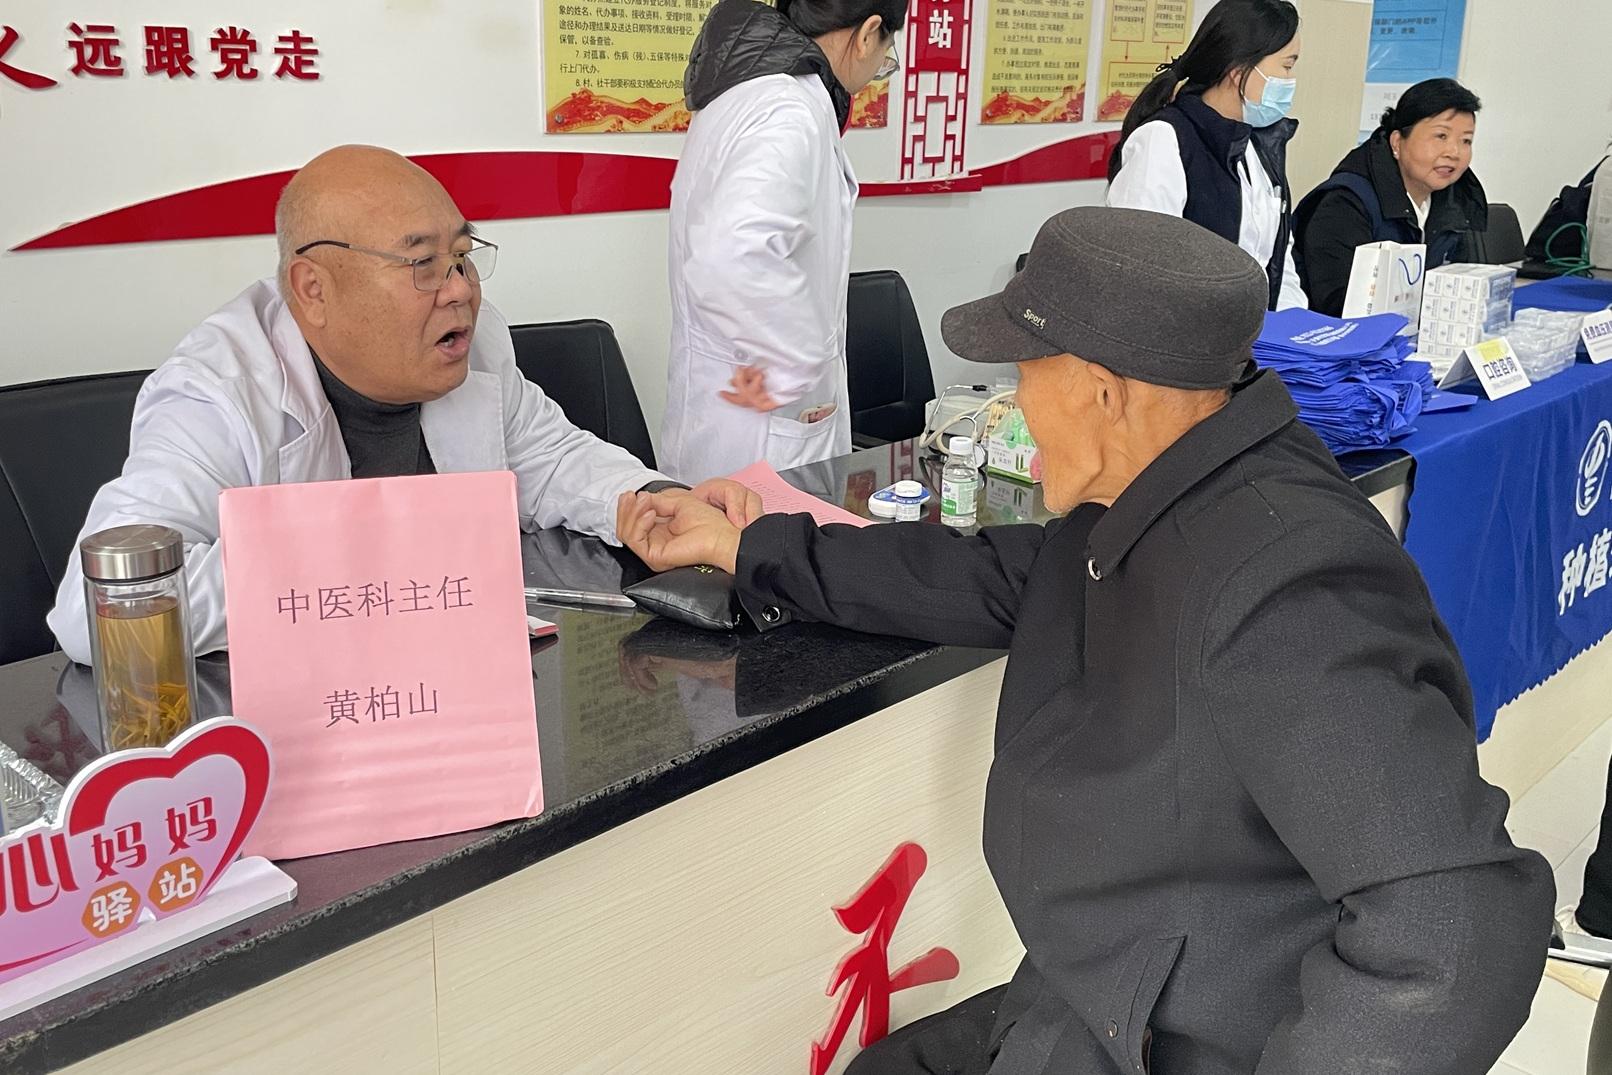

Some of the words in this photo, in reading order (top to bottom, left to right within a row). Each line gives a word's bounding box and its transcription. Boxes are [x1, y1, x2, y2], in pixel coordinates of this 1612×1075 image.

[928, 0, 954, 48] 站
[1024, 308, 1047, 330] Sport
[1483, 356, 1518, 380] 口腔咨询
[1558, 527, 1612, 616] 种植
[277, 575, 474, 625] 中医科主任
[322, 682, 439, 729] 黄柏山
[90, 863, 197, 932] 驿站
